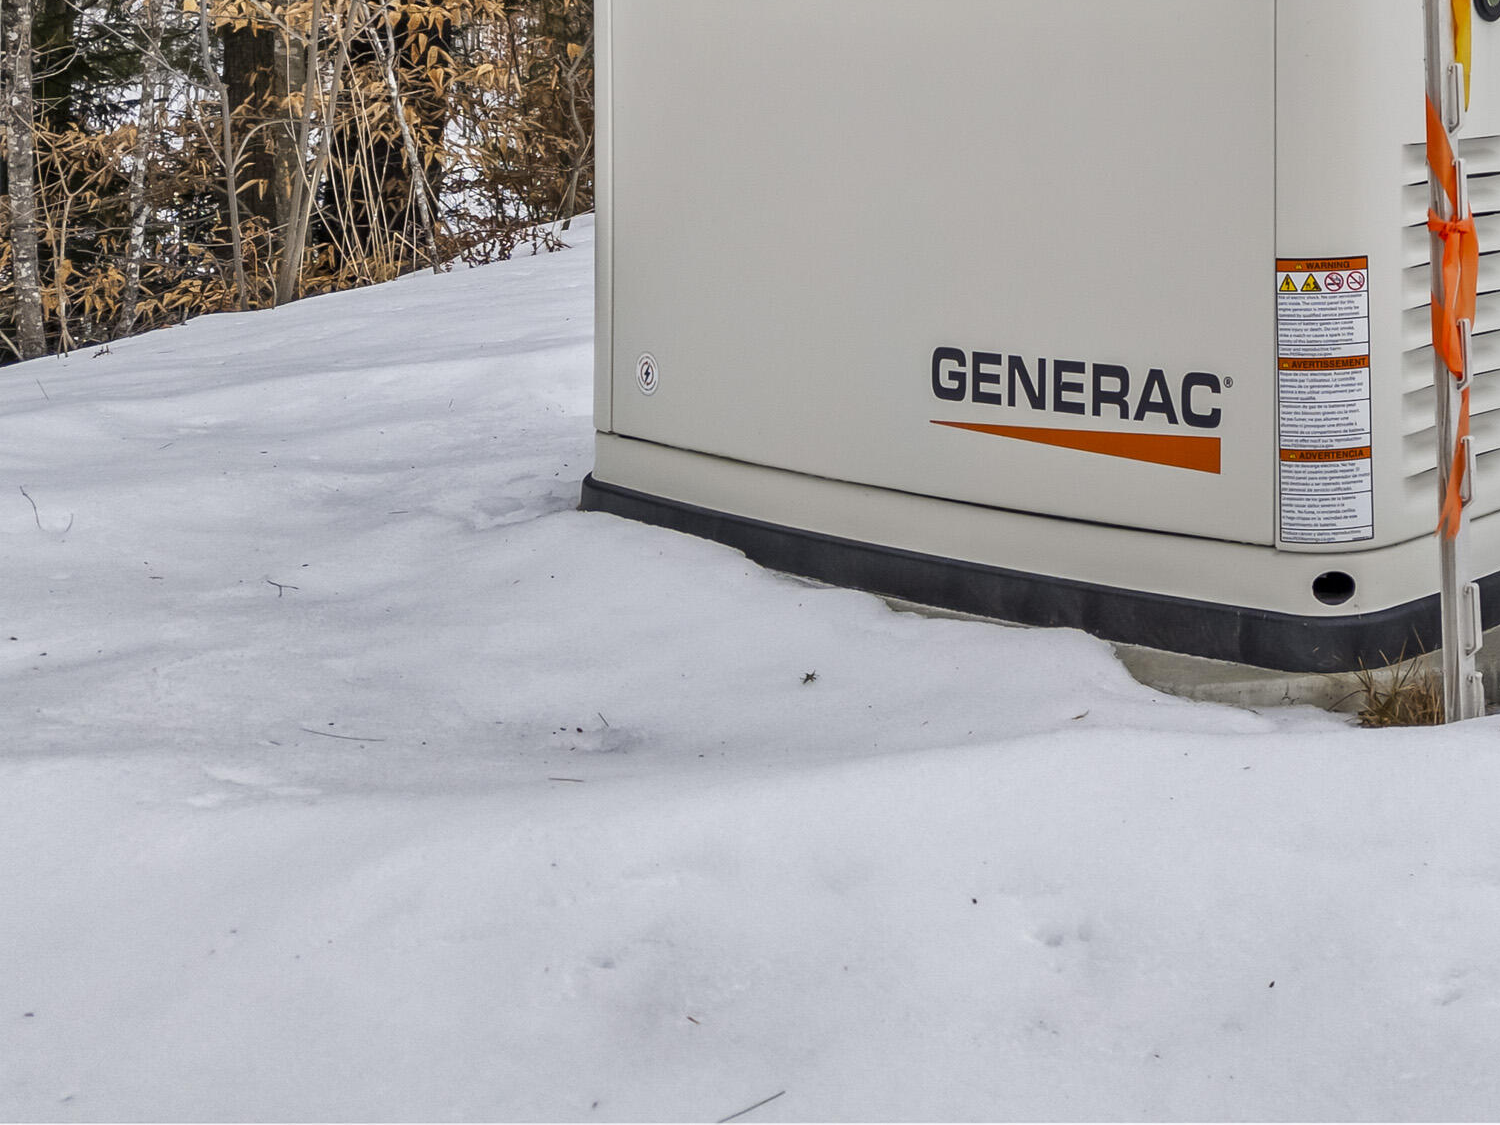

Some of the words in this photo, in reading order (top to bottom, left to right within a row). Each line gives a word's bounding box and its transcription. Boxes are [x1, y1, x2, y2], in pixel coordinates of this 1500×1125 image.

[1306, 261, 1350, 270] WARNING
[1292, 358, 1366, 368] AVERTISSEMENT
[1300, 450, 1364, 460] ADVERTENCIA
